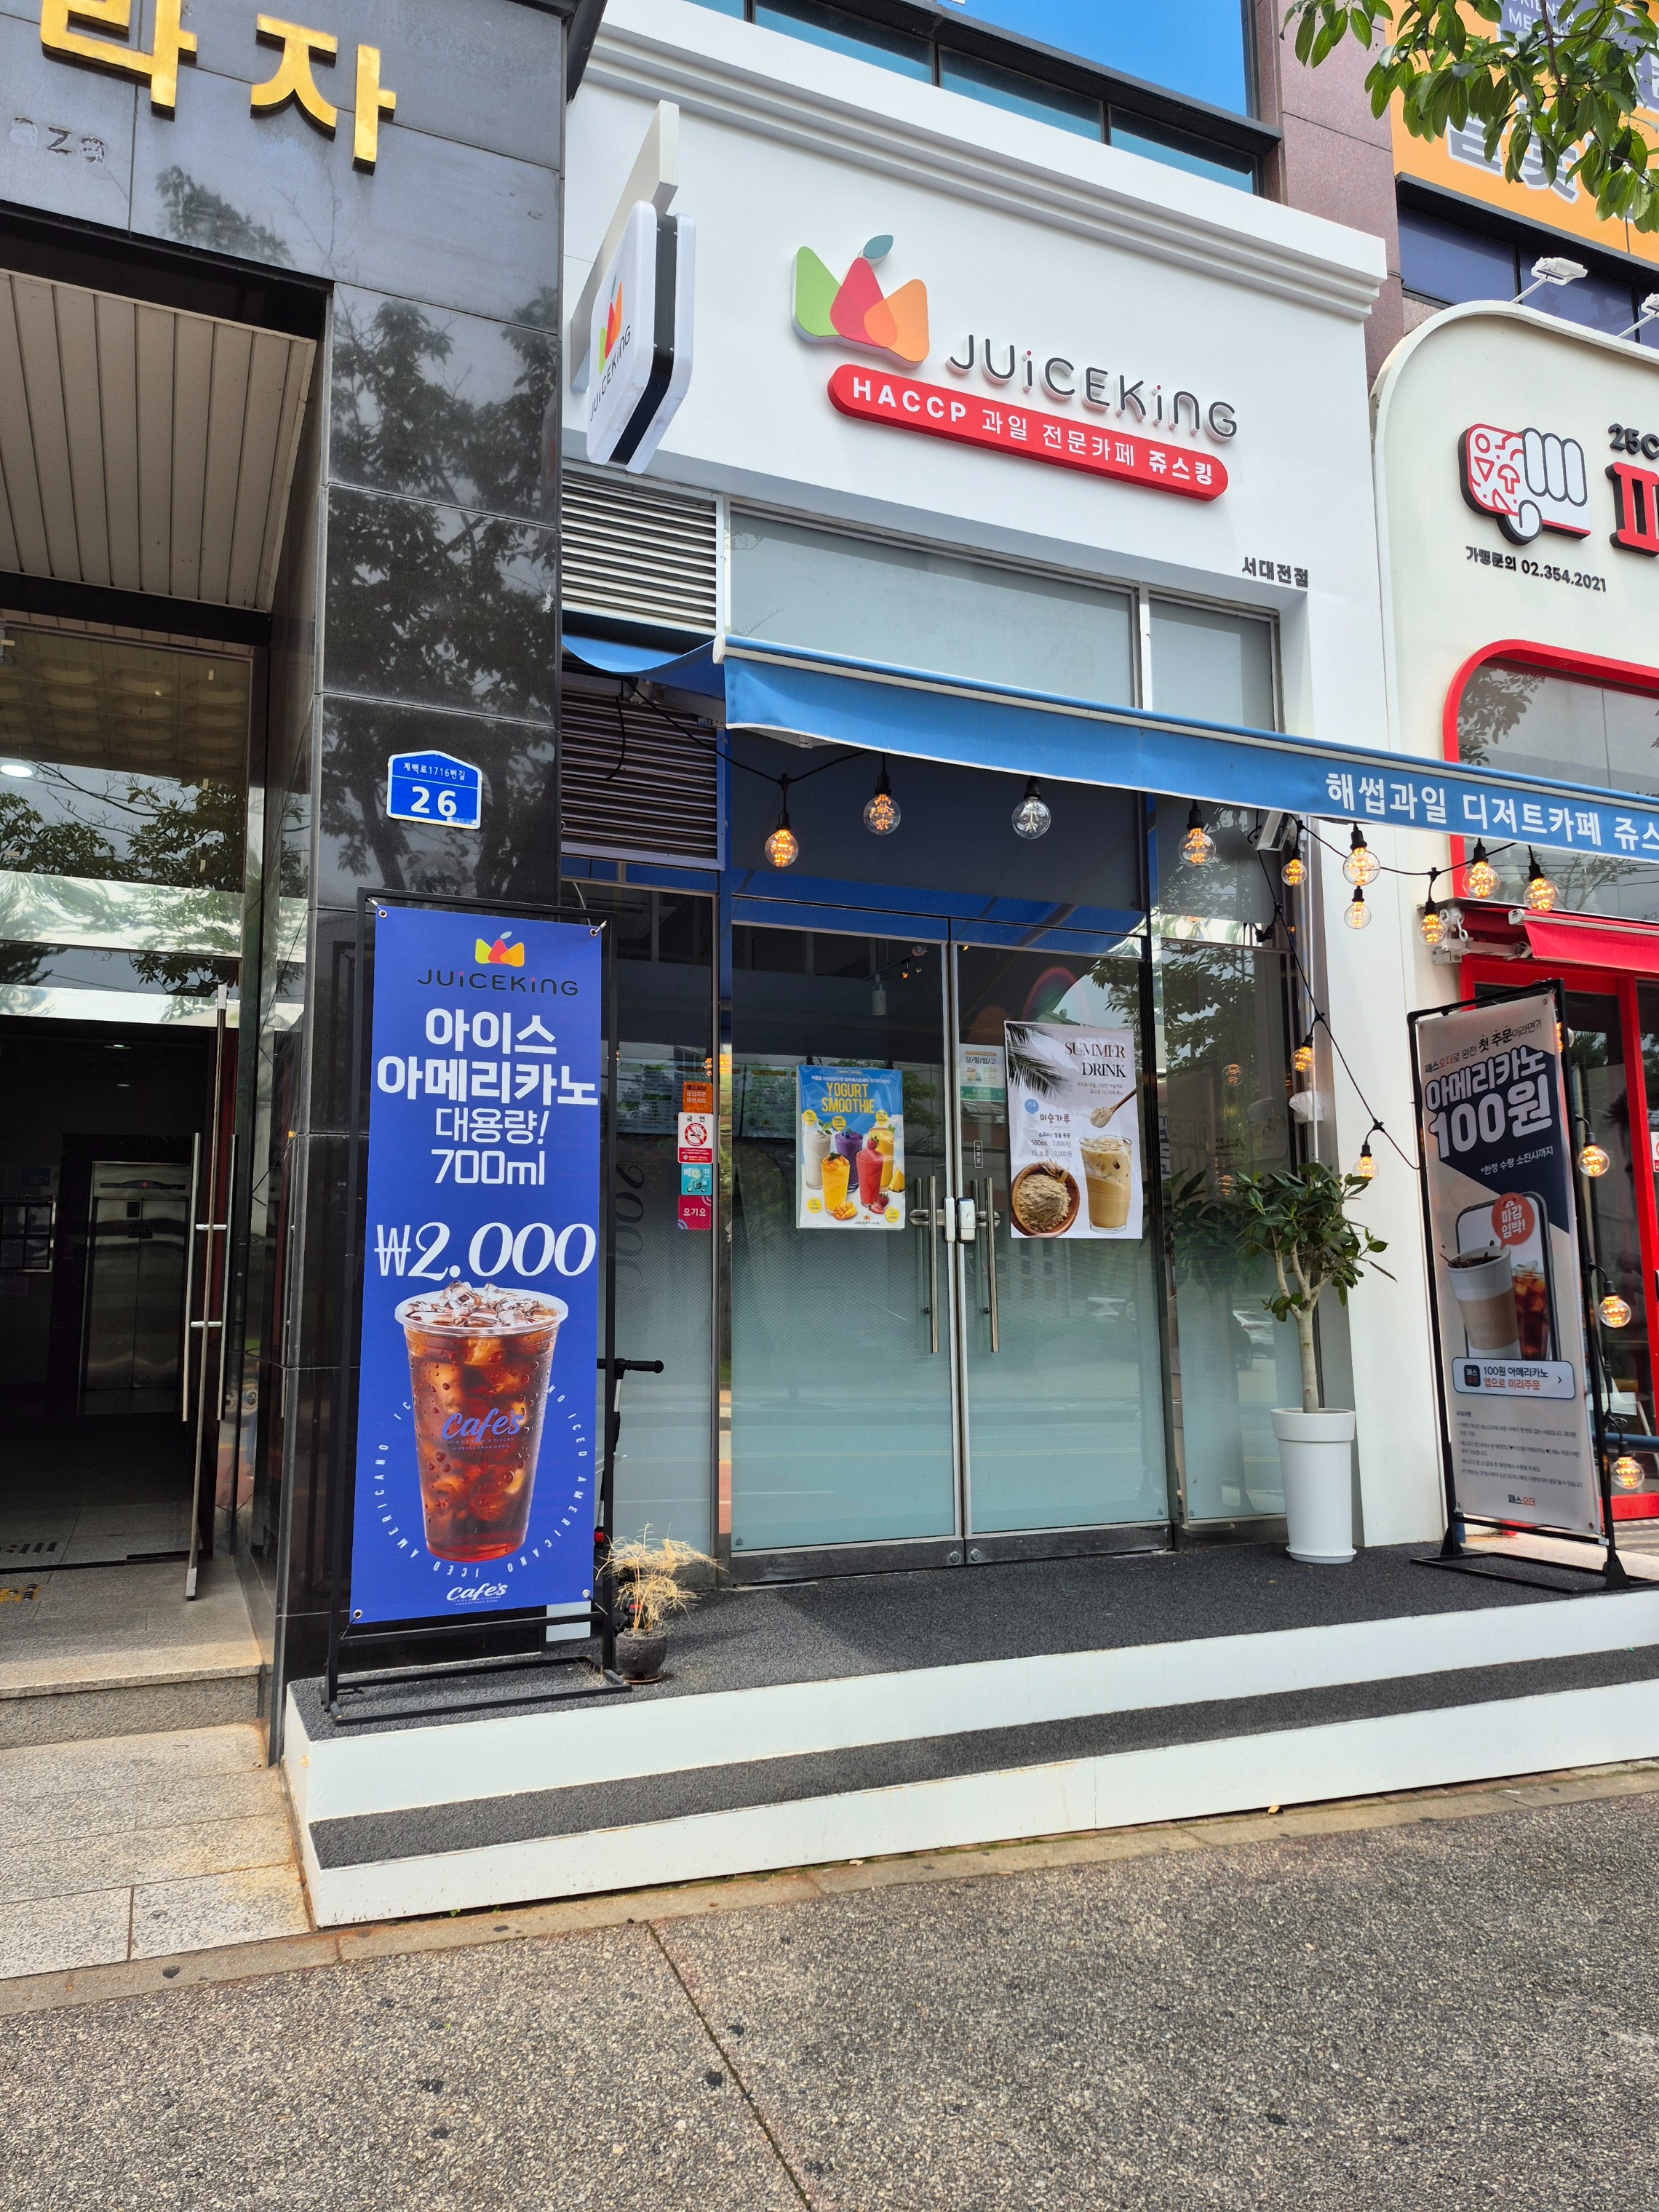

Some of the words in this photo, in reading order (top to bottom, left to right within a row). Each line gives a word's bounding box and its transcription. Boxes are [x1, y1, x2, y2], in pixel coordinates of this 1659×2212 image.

[851, 375, 967, 424] HACCP
[981, 408, 1030, 442] 과일
[1042, 423, 1135, 468] 전문카페
[1147, 449, 1213, 486] 쥬스킹
[1241, 555, 1309, 589] 서대전점
[1465, 546, 1516, 571] 가맹문의
[1521, 560, 1607, 592] 02.354.2021
[403, 763, 466, 781] 계백로1716번길
[410, 786, 457, 817] 26
[1326, 772, 1447, 825] 해썹과일
[1463, 793, 1602, 846] 디저트카페
[425, 1008, 557, 1055] 아이스
[1065, 1041, 1126, 1058] SUMMER
[1424, 1052, 1460, 1073] 패스오더로
[1461, 1045, 1477, 1061] 완전
[1478, 1036, 1489, 1051] 첫
[376, 1056, 599, 1106] 아메리카노
[1082, 1062, 1126, 1078] DRINK
[1425, 1046, 1546, 1110] 아메리카노
[821, 1097, 875, 1113] SMOOTHIE
[826, 1082, 869, 1097] YOGURT
[435, 1107, 549, 1145] 대용량!
[1040, 1113, 1070, 1123] 미숫가루
[1430, 1074, 1553, 1158] 100원
[431, 1149, 545, 1185] 700ml
[1500, 1158, 1514, 1170] 수량
[1516, 1145, 1553, 1166] 소진시까지
[683, 1207, 706, 1217] 요기요
[1501, 1204, 1522, 1224] 마감
[1501, 1220, 1526, 1239] 임박!
[373, 1221, 597, 1281] ₩2.000
[1484, 1366, 1505, 1376] 100원
[1508, 1367, 1548, 1378] 아메리카노
[1484, 1378, 1505, 1388] 앱으로
[1508, 1380, 1540, 1391] 미리주문
[568, 1413, 588, 1457] ICED
[373, 1443, 420, 1559] AMERICANO
[507, 1476, 588, 1572] AMERICANO
